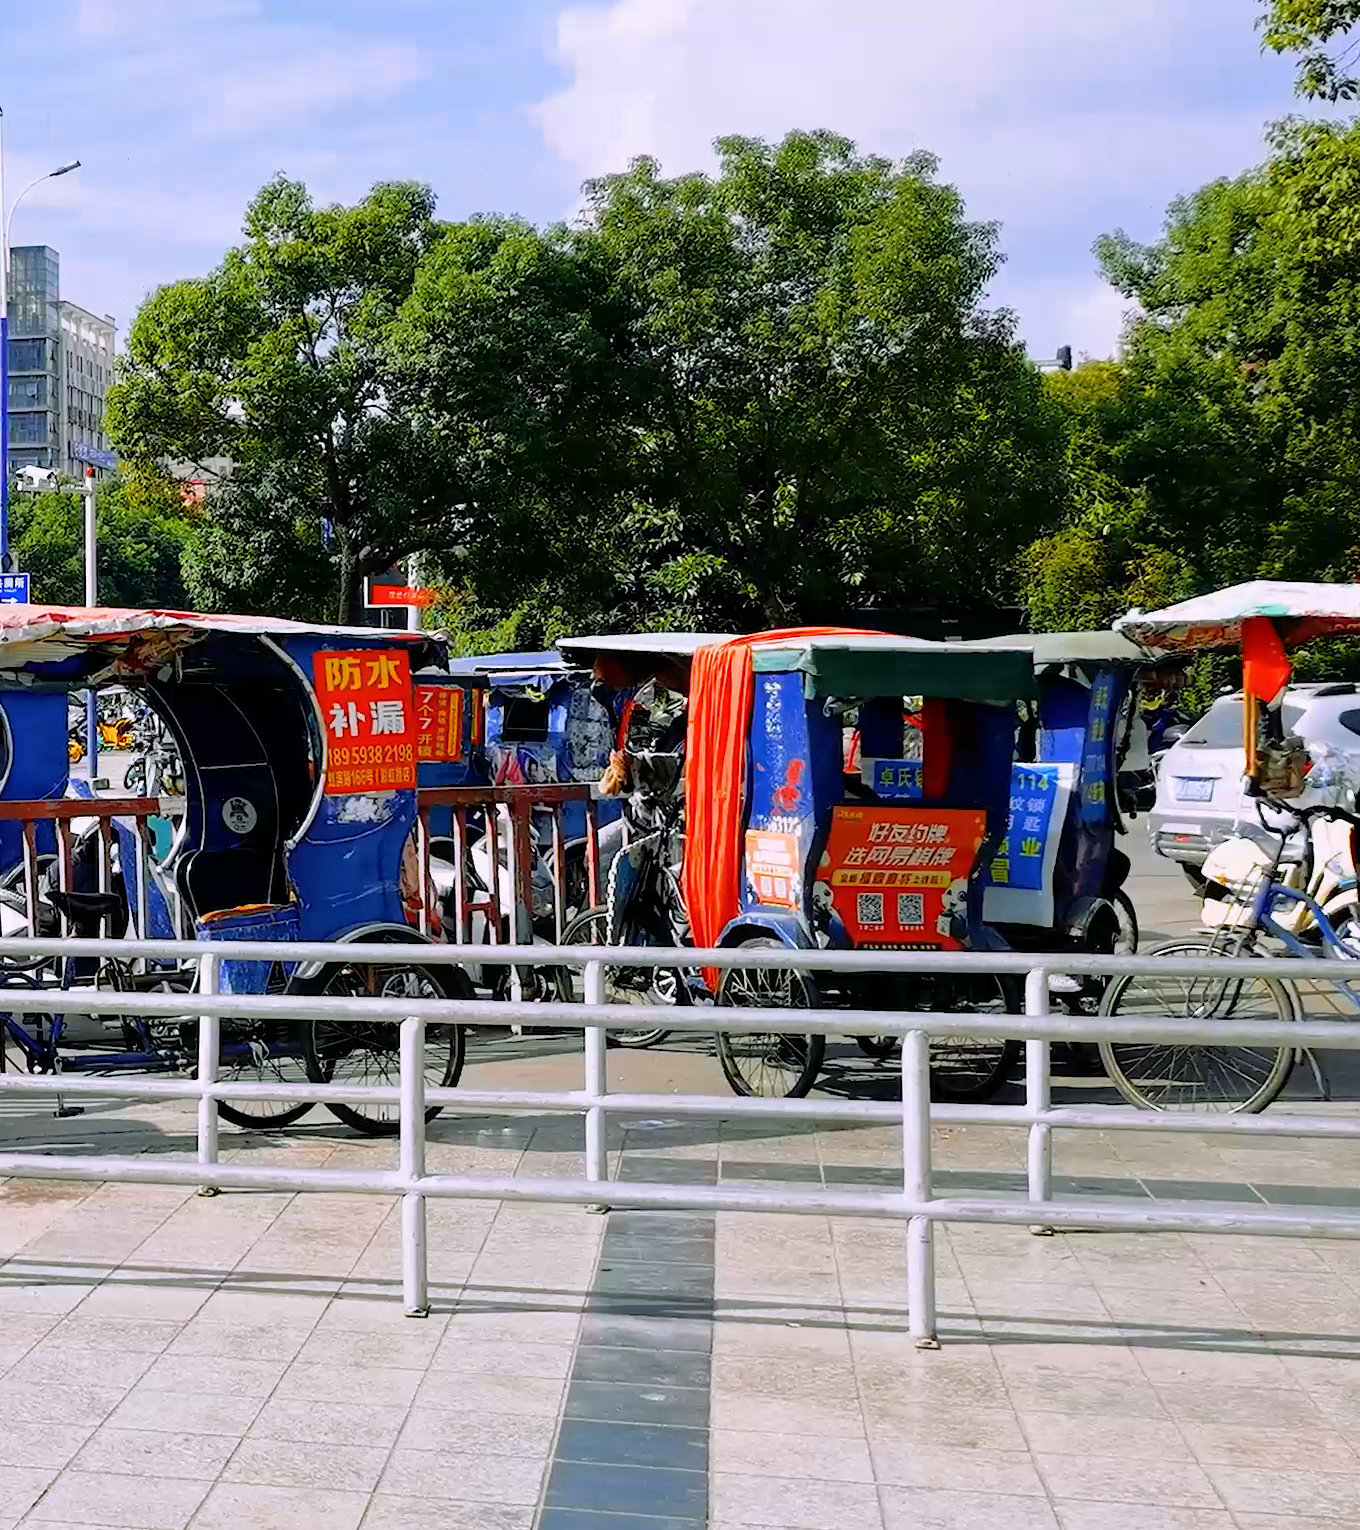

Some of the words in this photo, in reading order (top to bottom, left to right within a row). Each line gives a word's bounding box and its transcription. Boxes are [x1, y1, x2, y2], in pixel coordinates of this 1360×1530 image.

[324, 655, 403, 692] 防水
[329, 700, 406, 738] 补漏
[417, 691, 434, 757] 7个7开锁
[328, 747, 350, 766] 189
[351, 745, 383, 765] 5938
[384, 743, 413, 763] 2198
[1018, 773, 1049, 790] 114
[867, 822, 949, 844] 好友约牌
